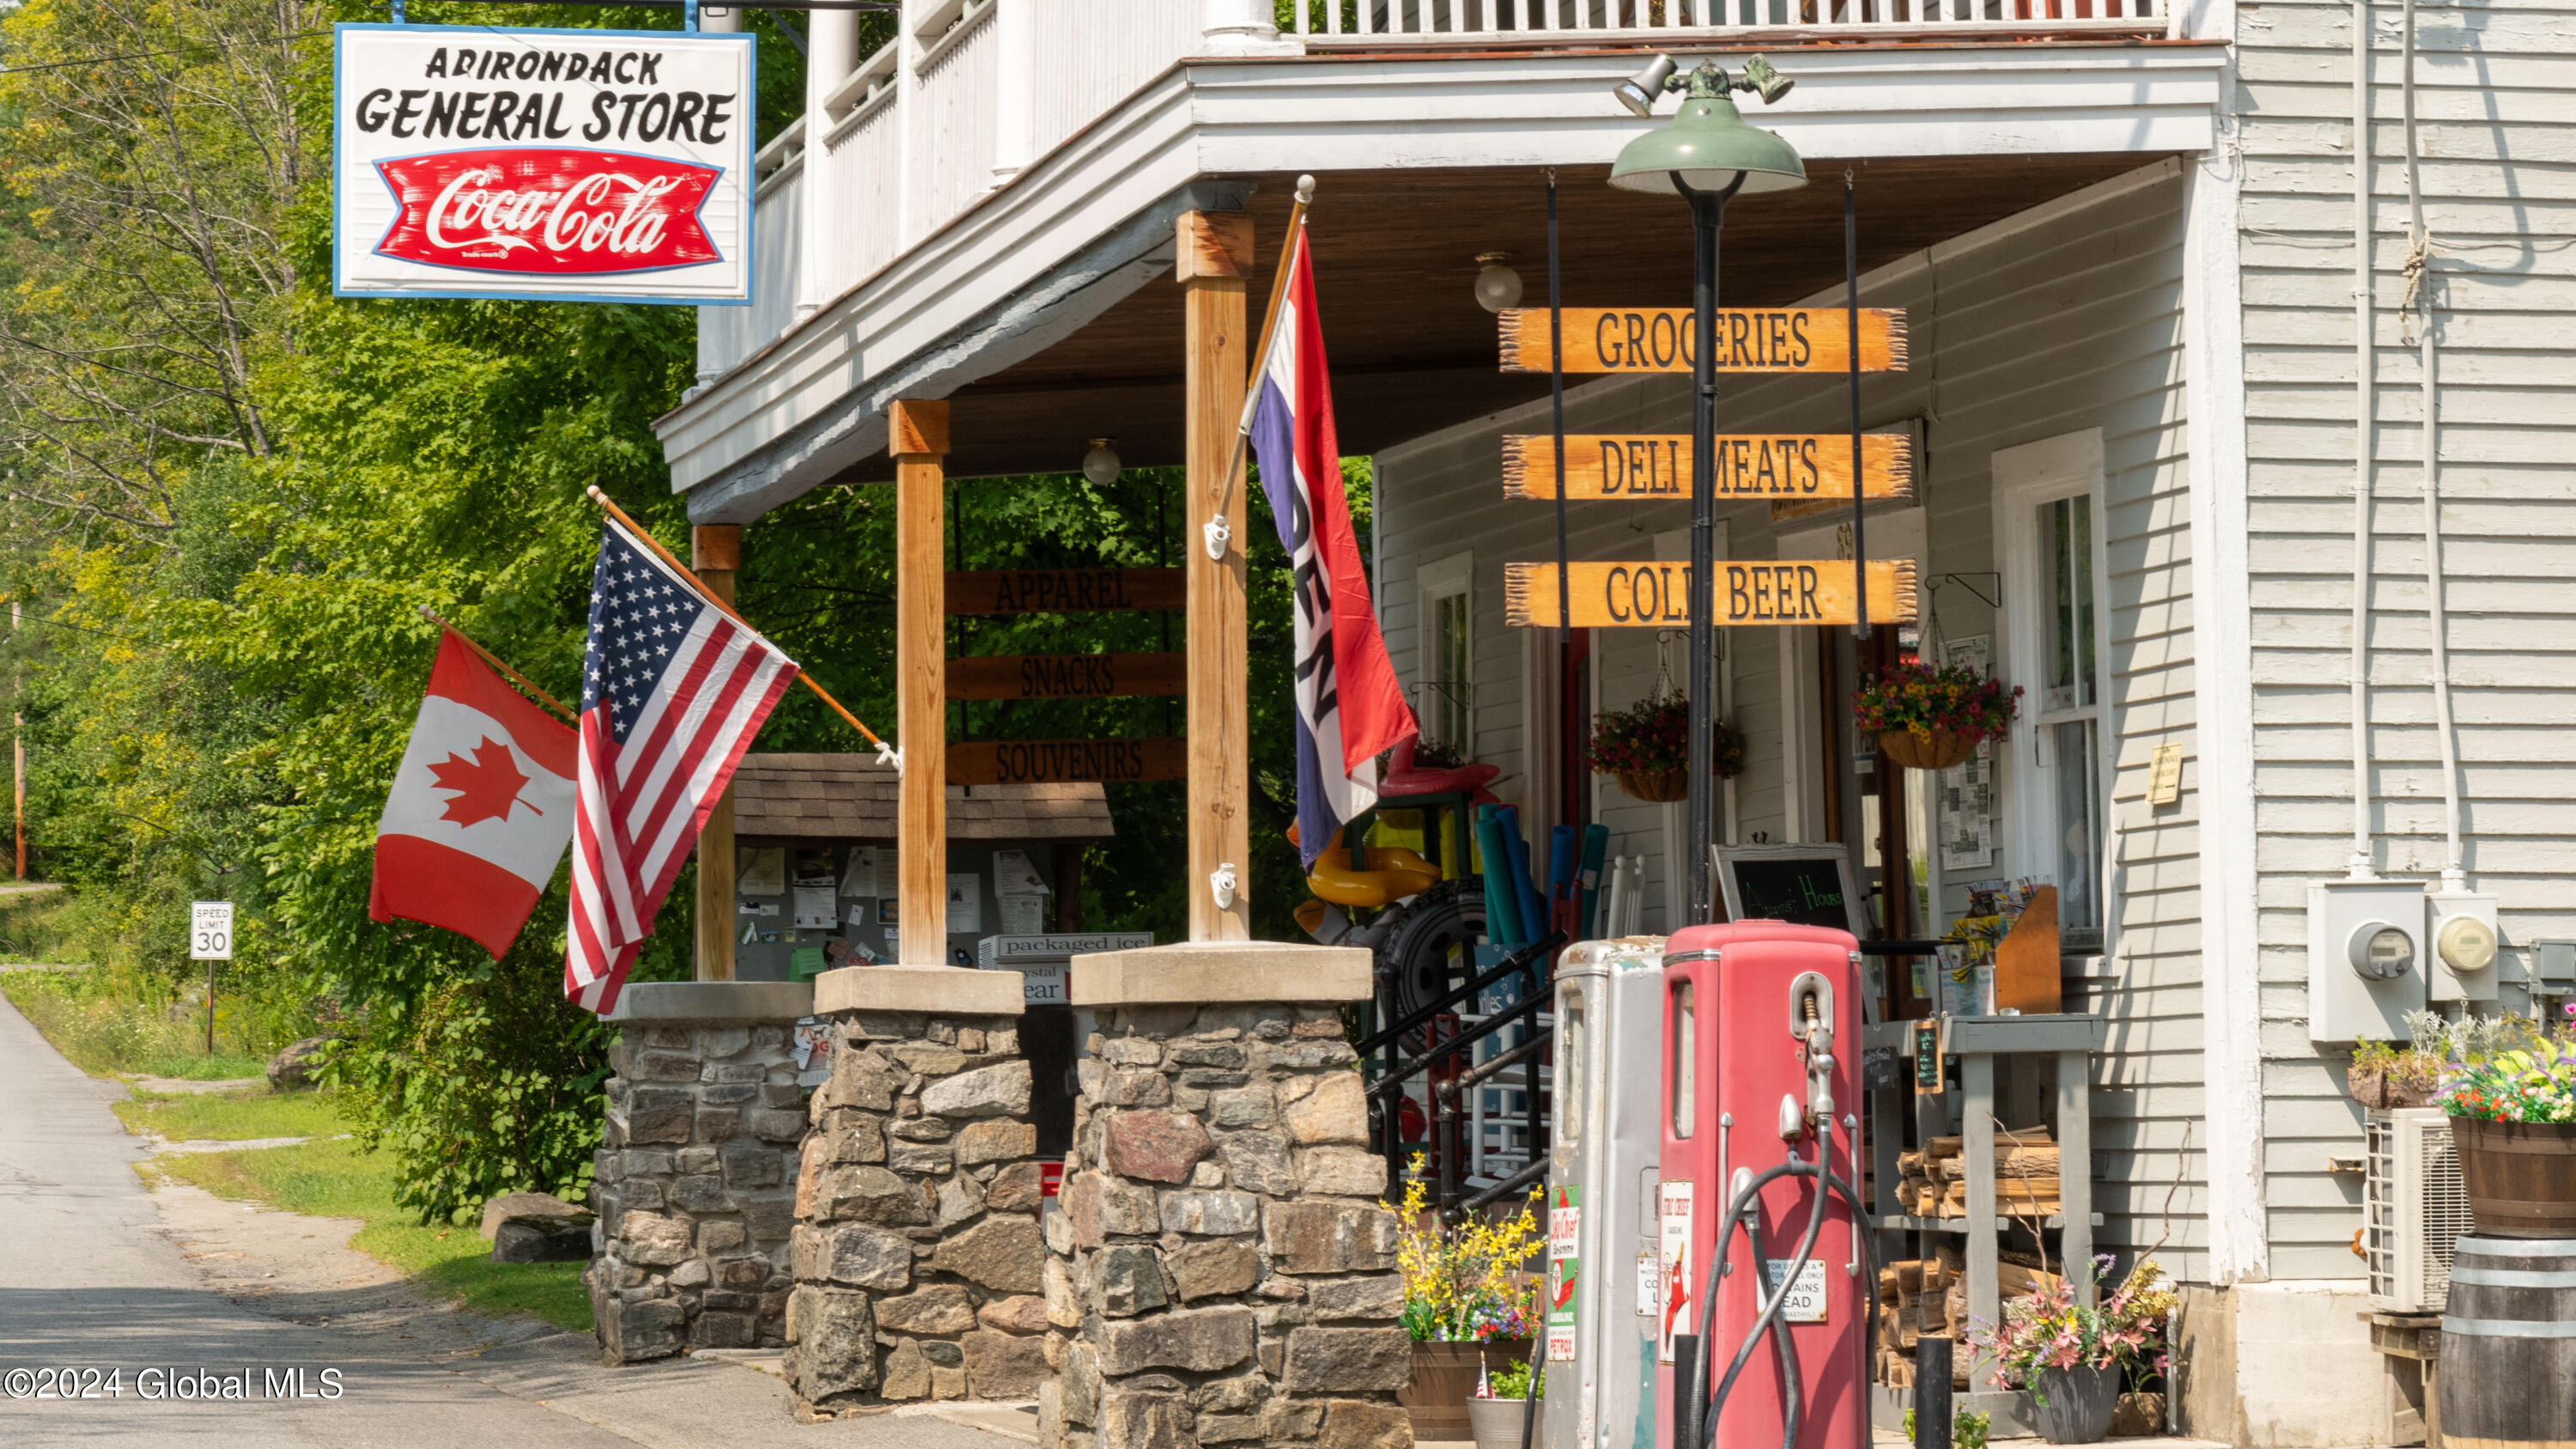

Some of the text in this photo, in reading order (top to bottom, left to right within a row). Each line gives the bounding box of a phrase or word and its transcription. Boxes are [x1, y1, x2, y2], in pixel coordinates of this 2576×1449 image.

[424, 47, 663, 85] ADIRONDACK
[355, 88, 736, 144] GENERAL STORE
[1600, 440, 1680, 495] DELI
[994, 570, 1132, 611] APPAREL
[1727, 565, 1822, 620] BEER
[1021, 656, 1115, 697] SNACKS
[996, 740, 1143, 782] SOUVENIRS
[196, 909, 228, 918] SPEED
[198, 921, 225, 929] LIMIT
[197, 932, 226, 952] 30
[1006, 936, 1145, 954] packaged ice
[1023, 966, 1056, 979] ystal
[1024, 983, 1060, 999] ear
[1783, 1295, 1811, 1307] EAD
